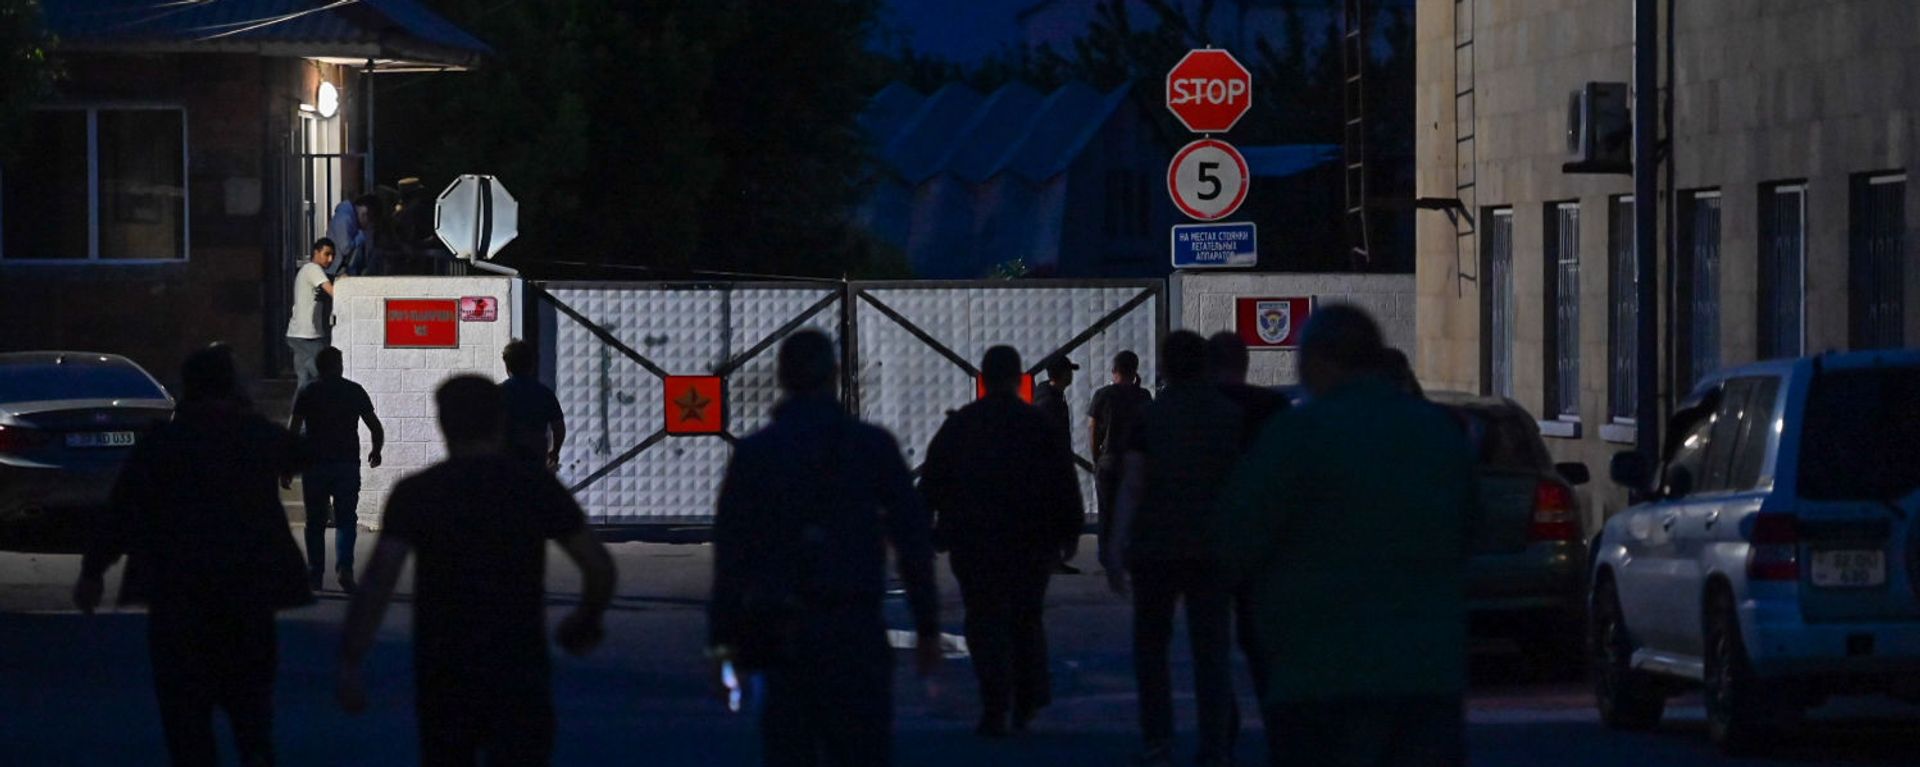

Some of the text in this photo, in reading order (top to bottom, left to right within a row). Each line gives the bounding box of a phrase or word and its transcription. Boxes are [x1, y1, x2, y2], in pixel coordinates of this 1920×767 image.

[1172, 79, 1245, 105] STOP
[1197, 162, 1222, 200] 5
[1179, 231, 1249, 242] НА МЕСТАХ СТОЯНКИ
